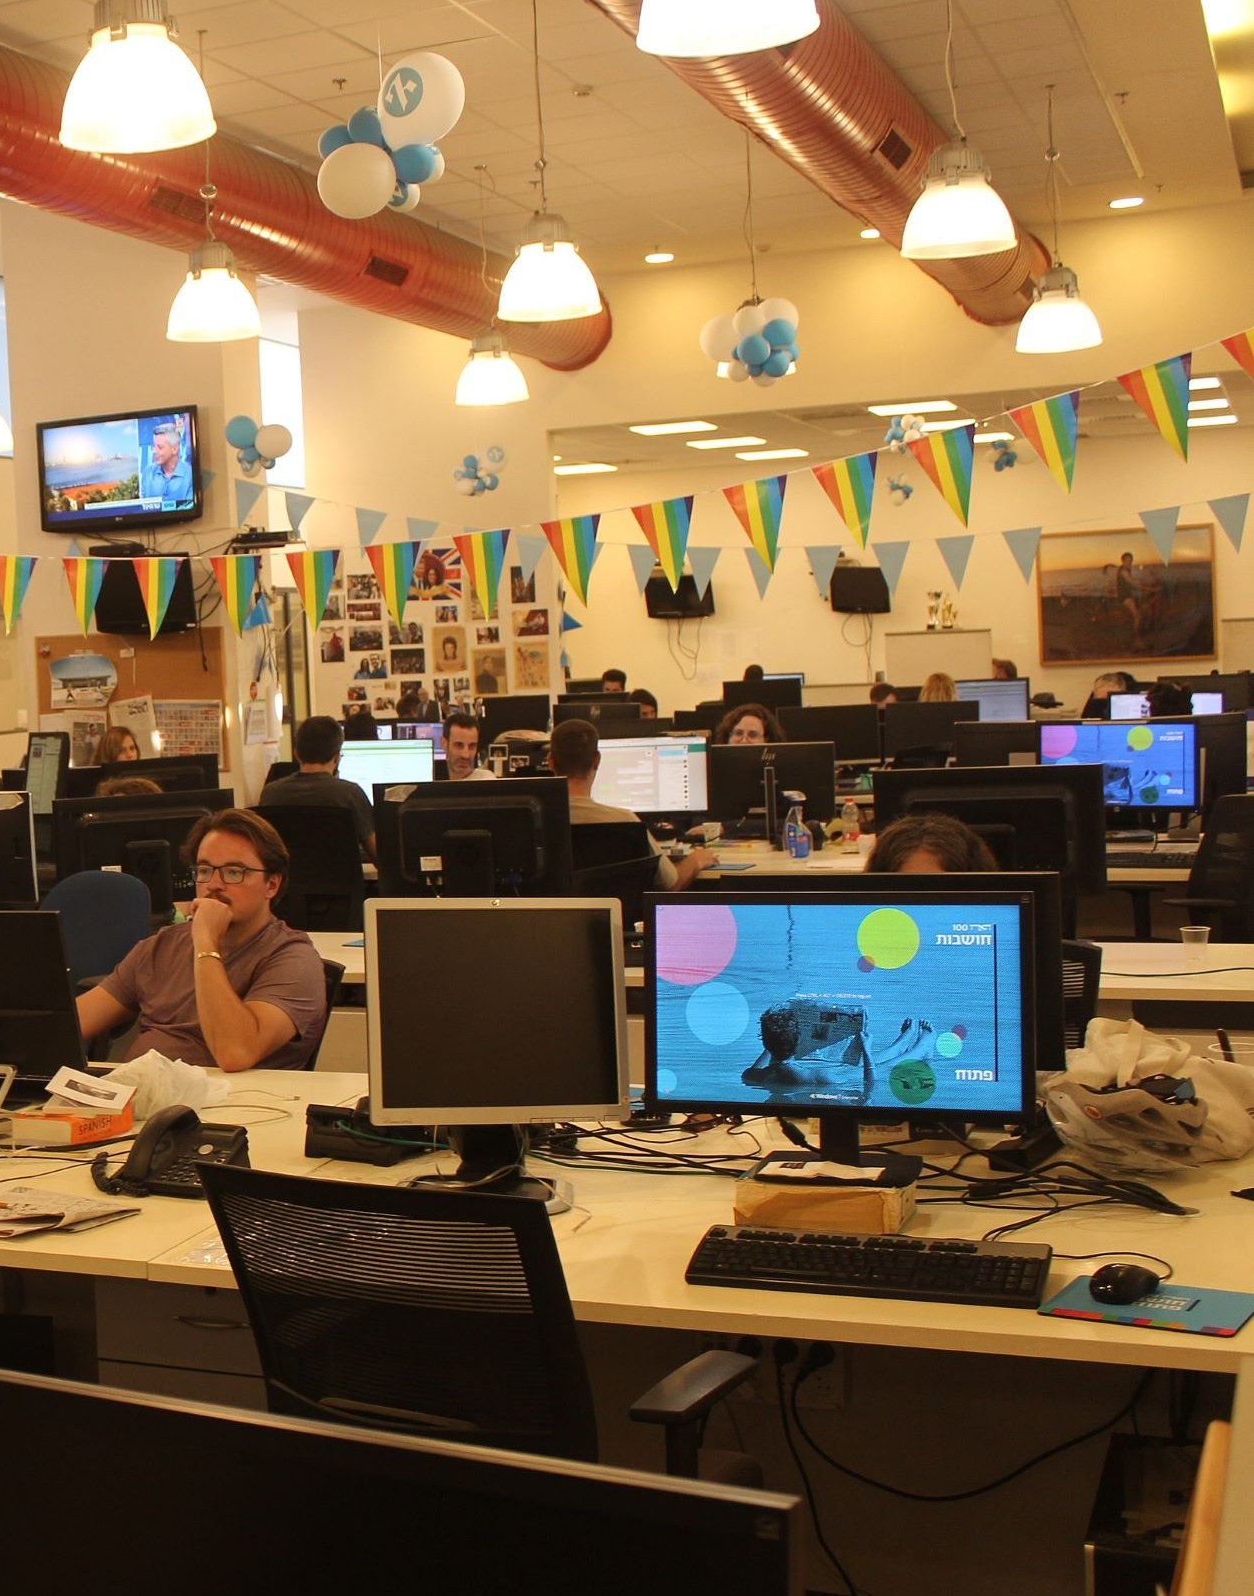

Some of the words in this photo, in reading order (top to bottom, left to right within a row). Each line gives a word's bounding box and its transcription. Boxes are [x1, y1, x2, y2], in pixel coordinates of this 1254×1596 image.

[953, 923, 968, 932] 100
[935, 934, 992, 946] חושבות
[954, 1069, 993, 1081] פתוח
[78, 1115, 112, 1136] SPANISH
